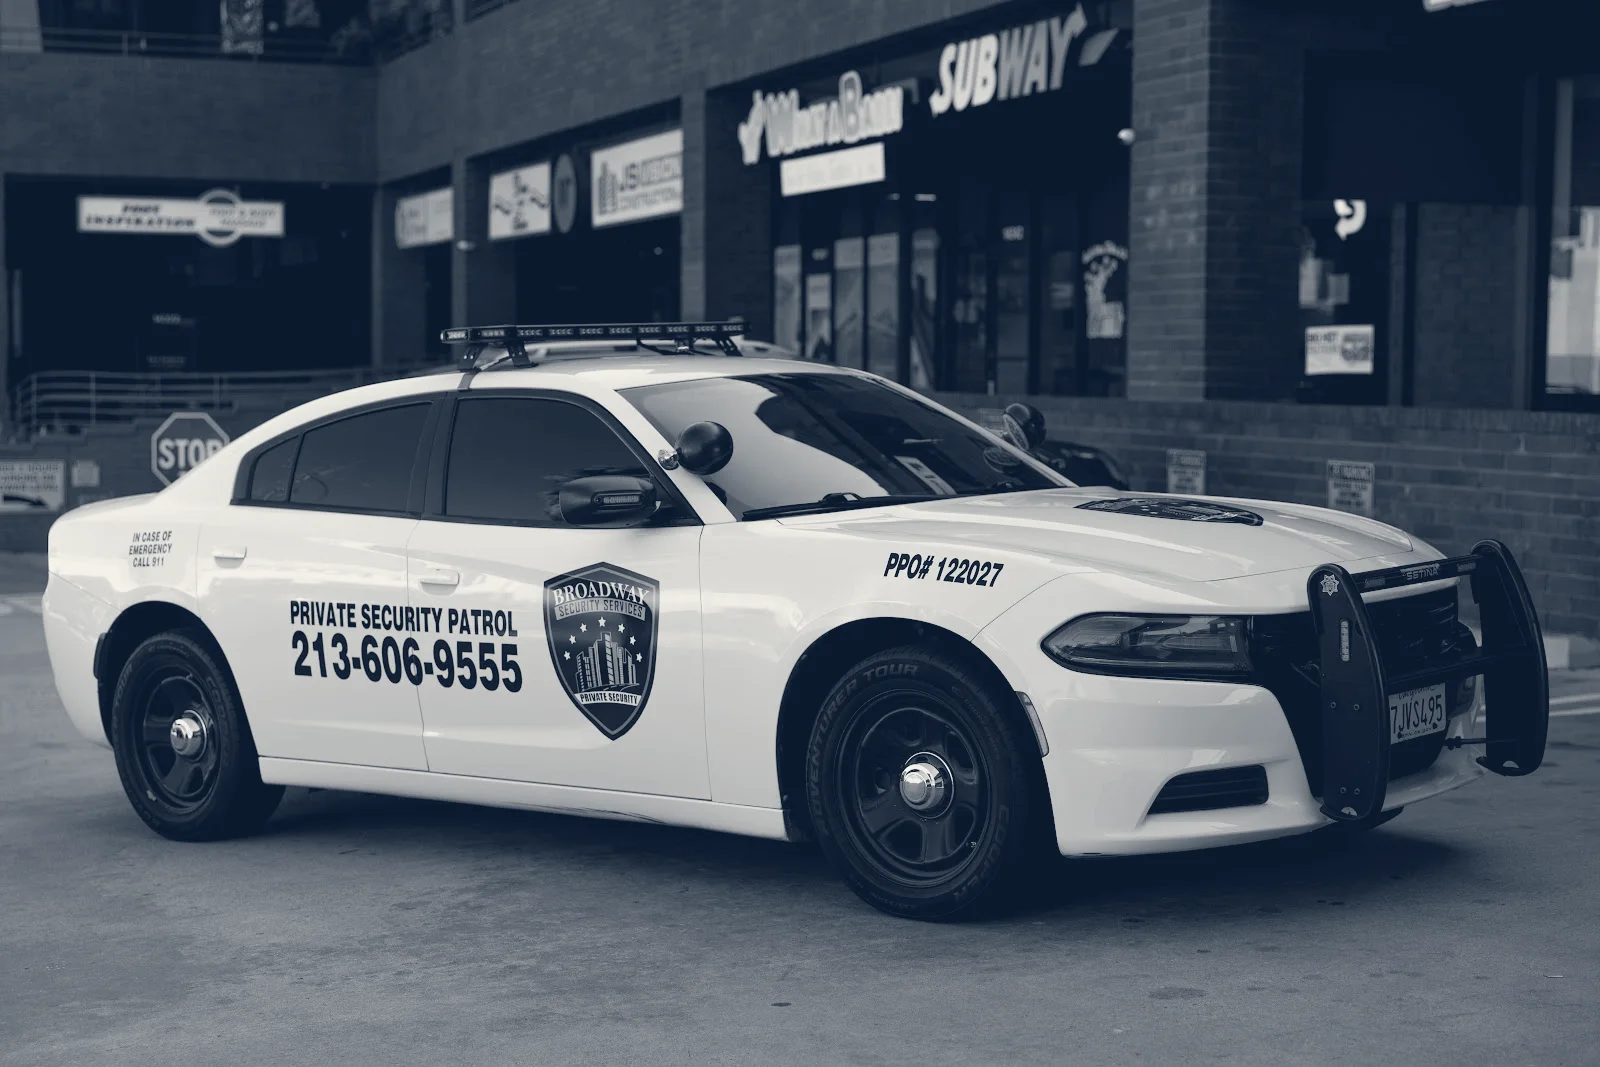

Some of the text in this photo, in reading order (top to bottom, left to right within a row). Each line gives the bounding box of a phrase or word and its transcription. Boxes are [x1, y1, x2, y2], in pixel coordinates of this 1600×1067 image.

[929, 1, 1087, 118] SUBWAY
[132, 530, 172, 542] IN CASE OF
[129, 543, 172, 555] EMERGENCY
[133, 557, 164, 567] CALL 911
[883, 552, 1004, 587] PPO# 122027
[1406, 566, 1439, 581] SETINA
[552, 581, 650, 606] BROADWAY
[290, 600, 518, 637] PRIVATE SECURITY PATROL
[558, 600, 643, 618] SECURITY SERVICES
[291, 630, 523, 693] 213-606-9555
[862, 663, 921, 683] TOUR
[580, 692, 638, 705] PRIVATE SECURITY
[1390, 693, 1443, 735] 7JVS495
